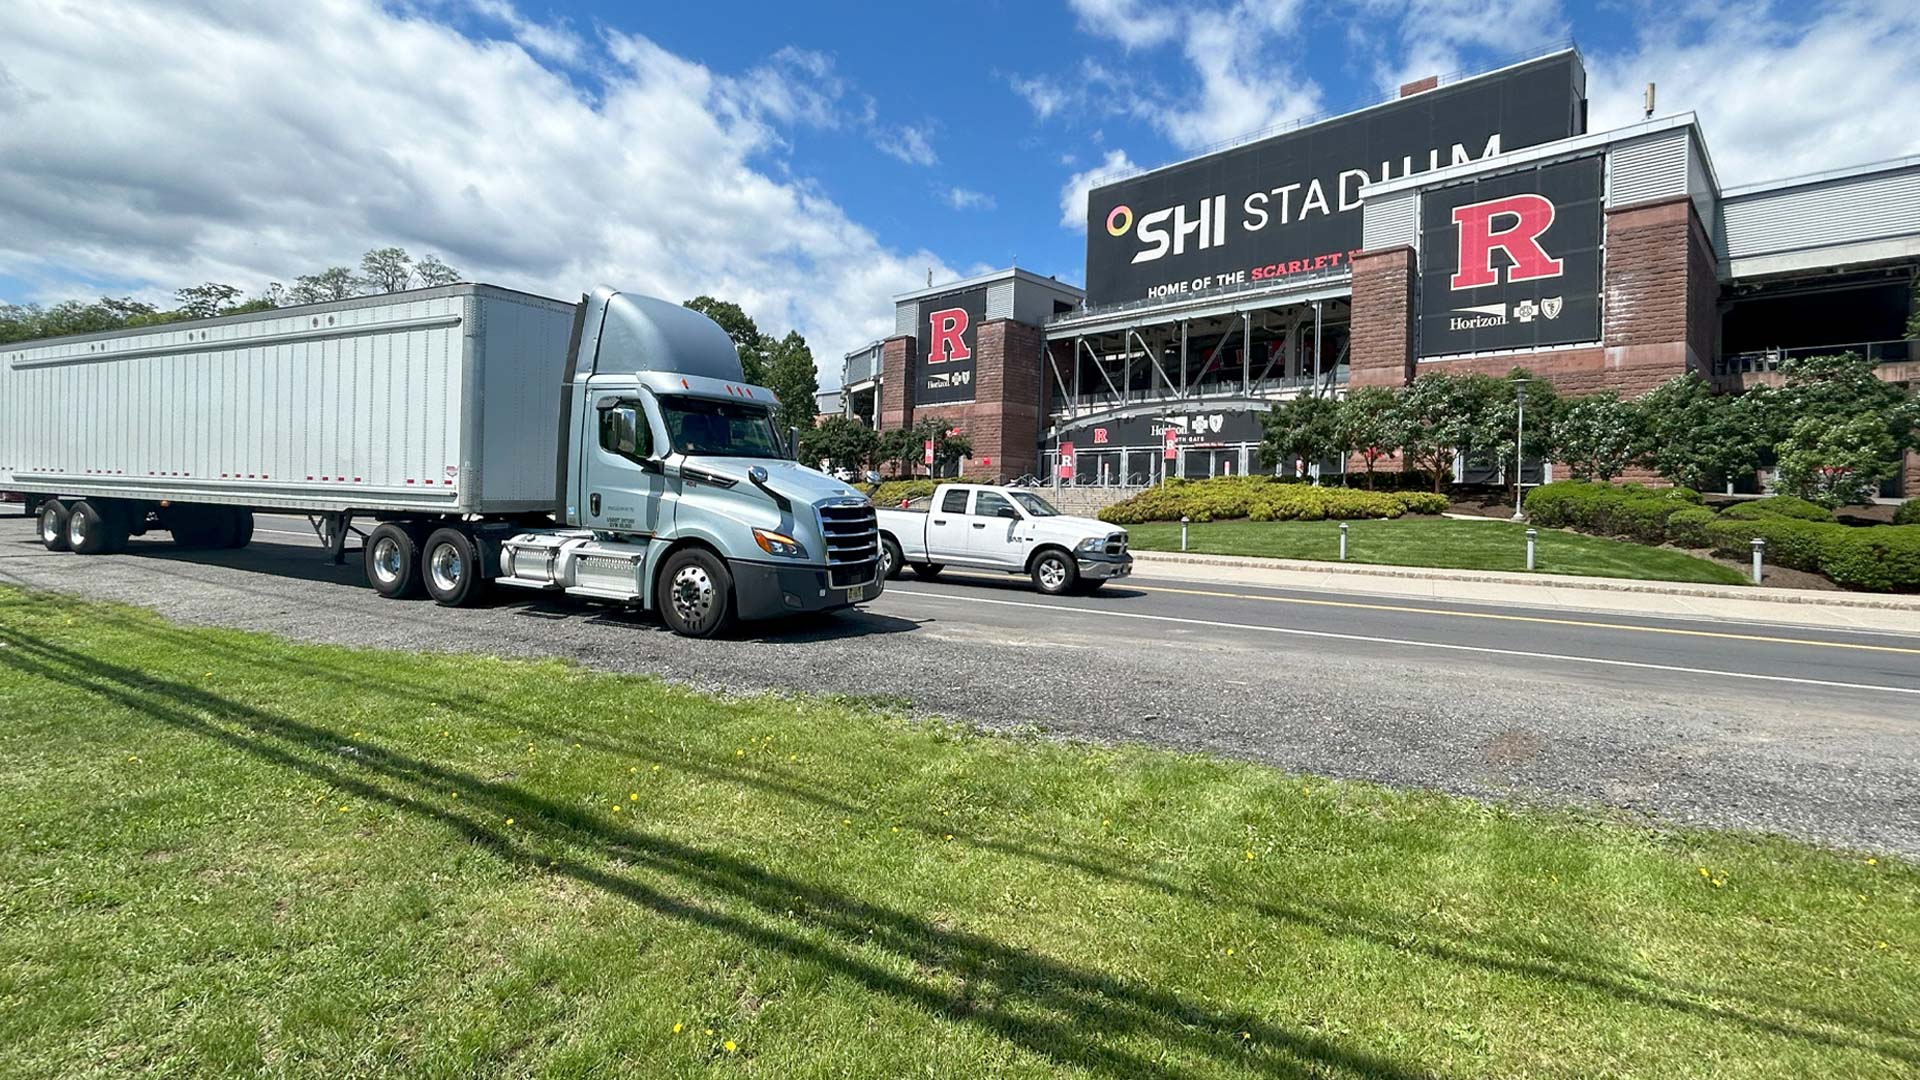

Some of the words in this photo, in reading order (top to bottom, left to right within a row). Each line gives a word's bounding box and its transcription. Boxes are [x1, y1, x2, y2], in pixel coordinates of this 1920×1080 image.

[1131, 194, 1226, 264] SHI
[1450, 193, 1564, 291] R
[1148, 281, 1188, 299] HOME
[1192, 276, 1211, 291] OF
[1216, 270, 1245, 286] THE
[1251, 252, 1342, 280] SCARLET
[928, 307, 972, 365] R
[1449, 315, 1507, 331] Horizon
[1094, 428, 1108, 443] R
[1151, 424, 1188, 436] Hoon
[1061, 455, 1072, 467] R
